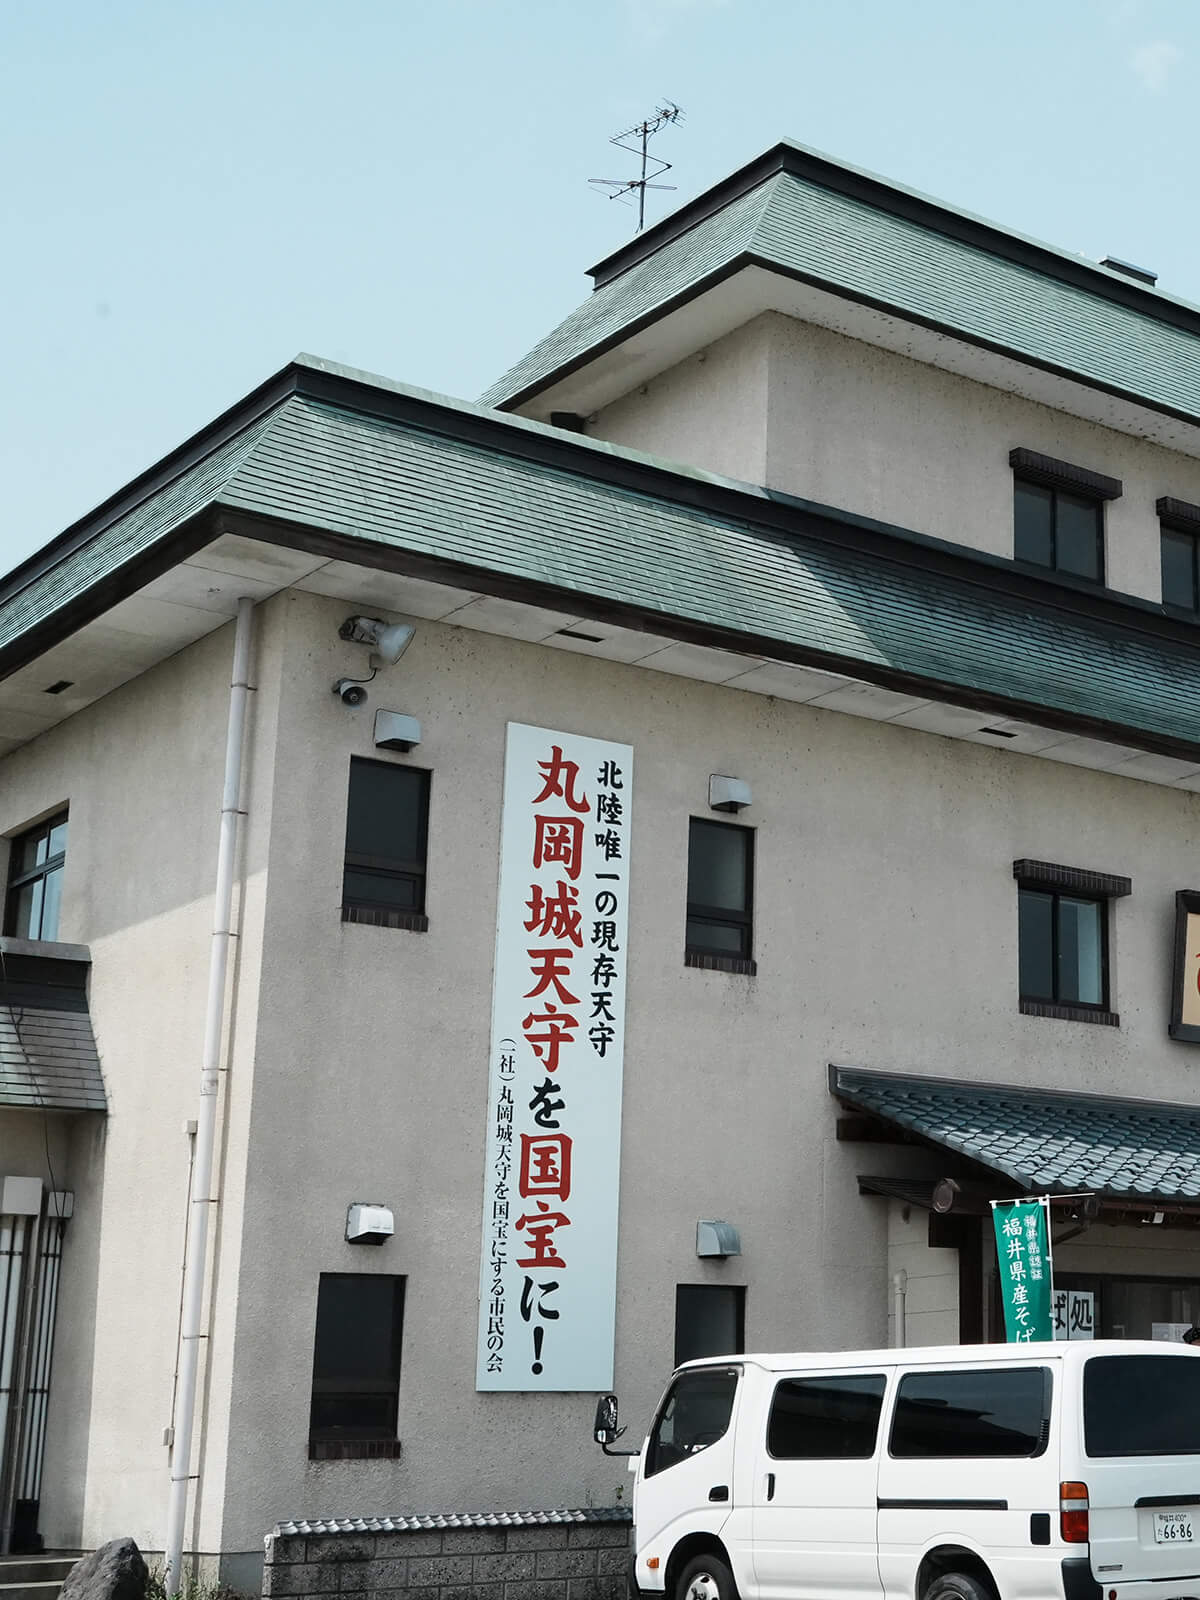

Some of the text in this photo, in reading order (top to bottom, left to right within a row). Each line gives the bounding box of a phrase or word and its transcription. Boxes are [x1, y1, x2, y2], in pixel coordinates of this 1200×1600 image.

[588, 759, 623, 1057] 北陸唯一の現存天守
